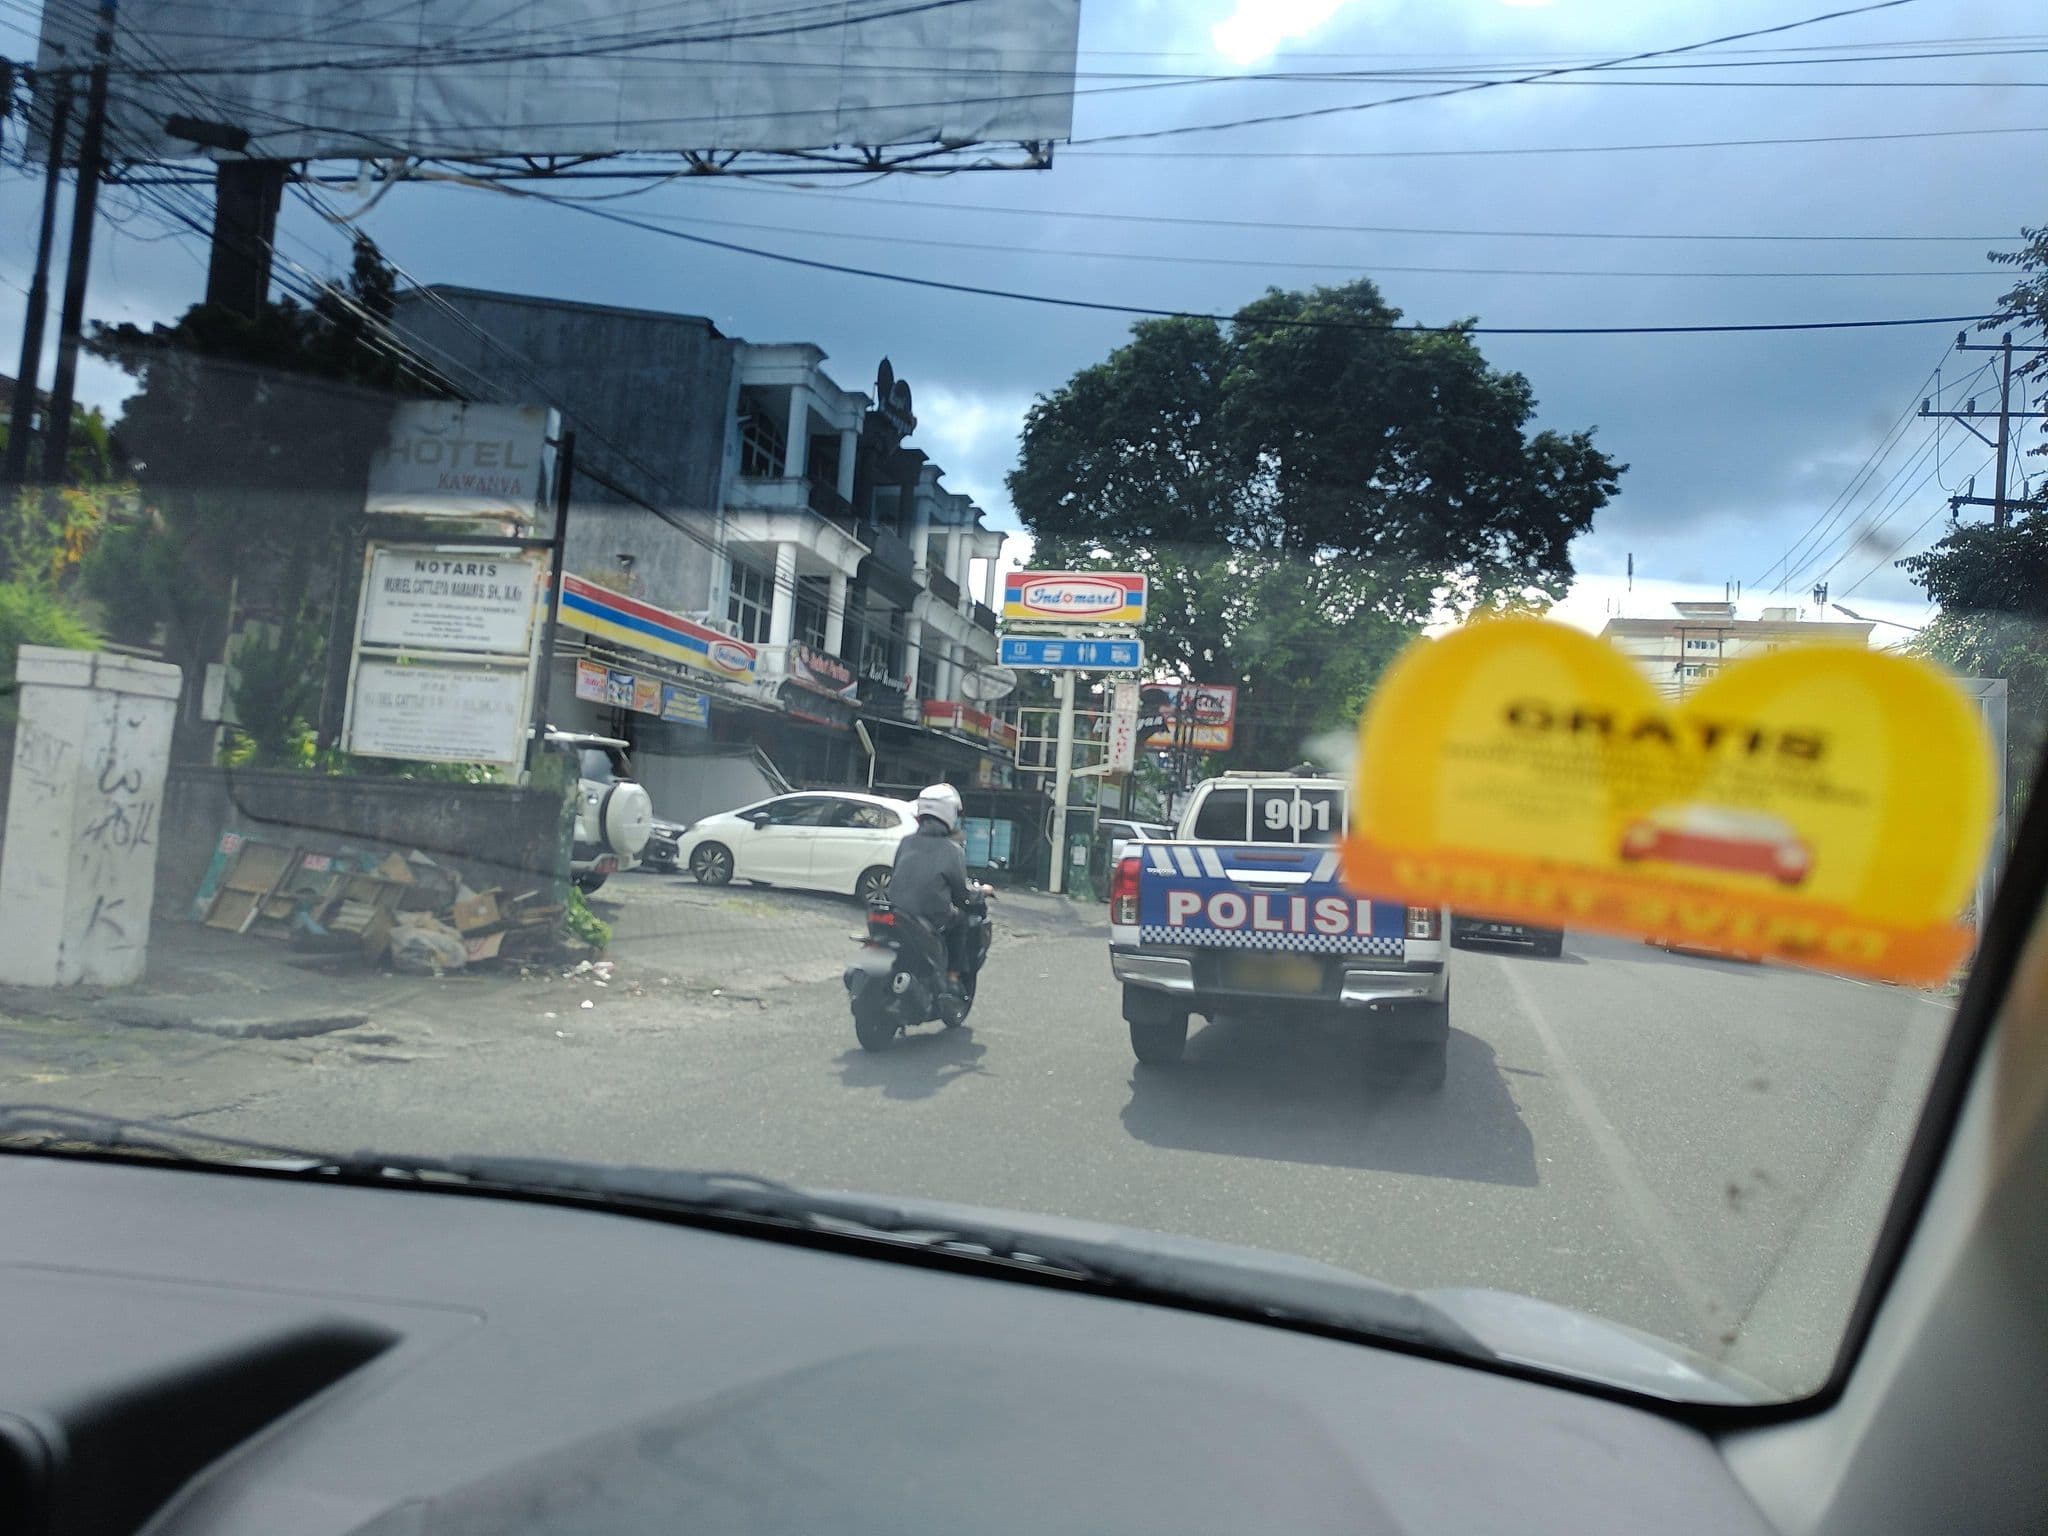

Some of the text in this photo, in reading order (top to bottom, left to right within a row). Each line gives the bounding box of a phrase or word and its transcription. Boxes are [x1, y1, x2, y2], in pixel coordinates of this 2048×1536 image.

[384, 438, 528, 470] HOTEL
[414, 560, 498, 577] NOTARIS
[1029, 587, 1118, 605] Indomaret
[1503, 699, 1830, 764] GRATIS
[1264, 798, 1331, 832] 901
[1166, 891, 1374, 936] POLISI
